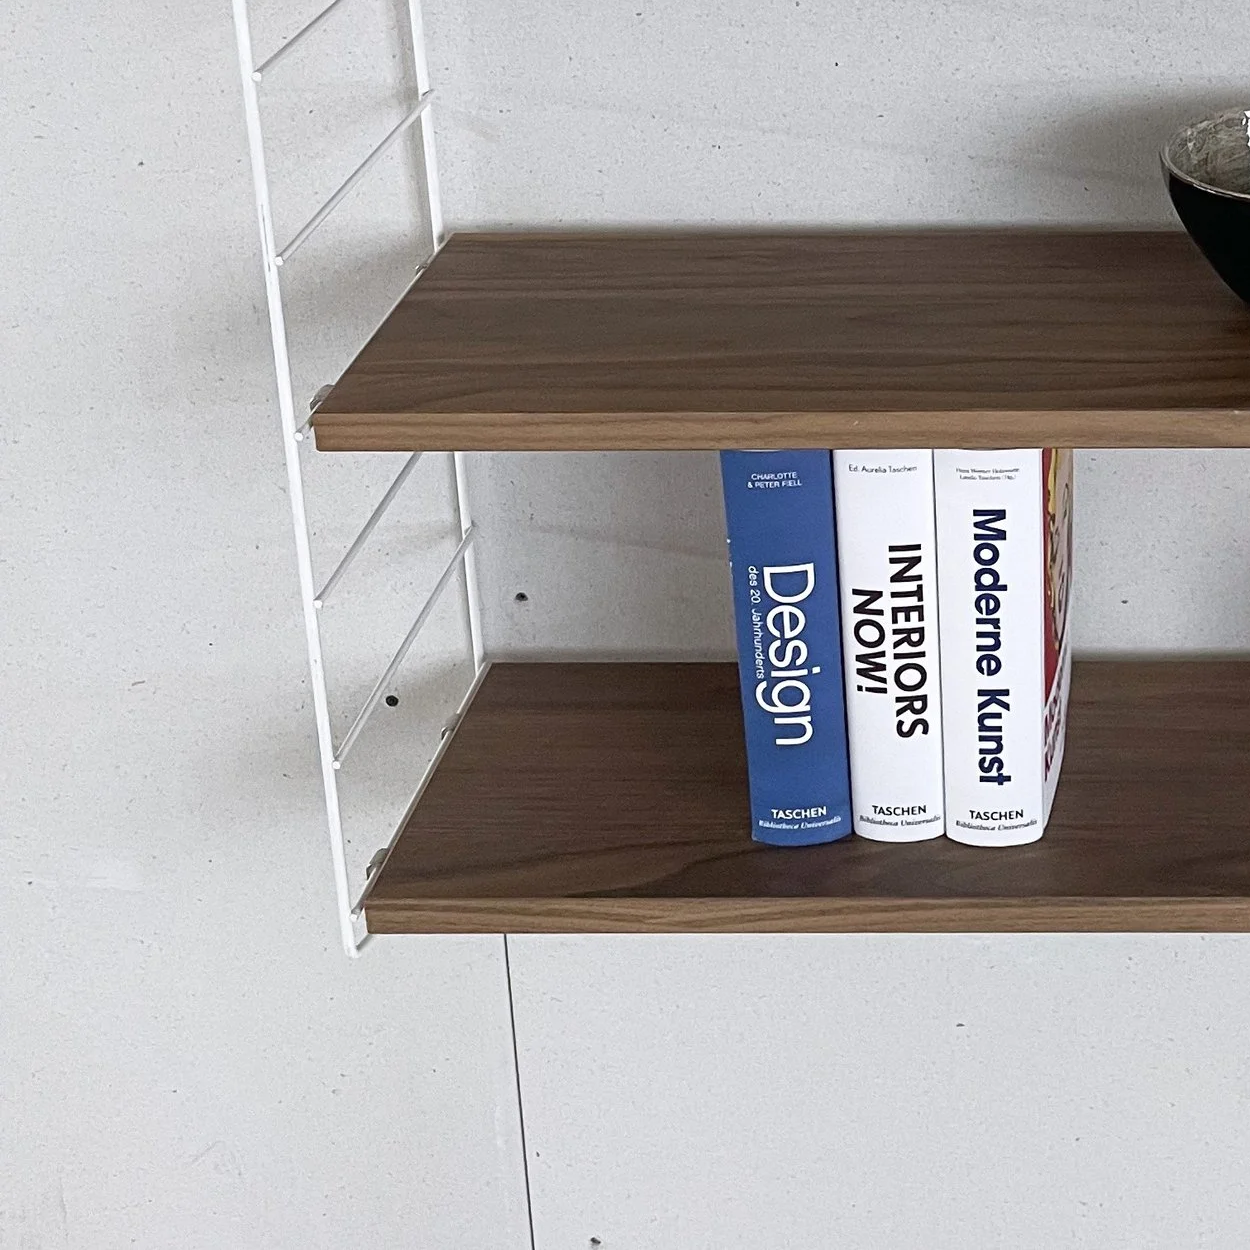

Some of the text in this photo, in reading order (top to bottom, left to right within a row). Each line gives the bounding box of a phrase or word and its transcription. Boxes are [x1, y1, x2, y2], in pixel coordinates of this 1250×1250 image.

[747, 481, 753, 489] &
[755, 481, 780, 489] PETER
[751, 471, 798, 481] CHARLOTTE
[748, 565, 760, 586] des
[973, 508, 1008, 677] Moderne
[751, 608, 767, 679] Jahrhunderts
[755, 562, 821, 746] Design
[852, 588, 888, 694] NOW!
[888, 543, 929, 738] INTERIORS
[977, 689, 1012, 786] Kunst
[771, 806, 827, 819] TASCHEN
[872, 805, 927, 817] TASCHEN
[969, 809, 1024, 821] TASCHEN
